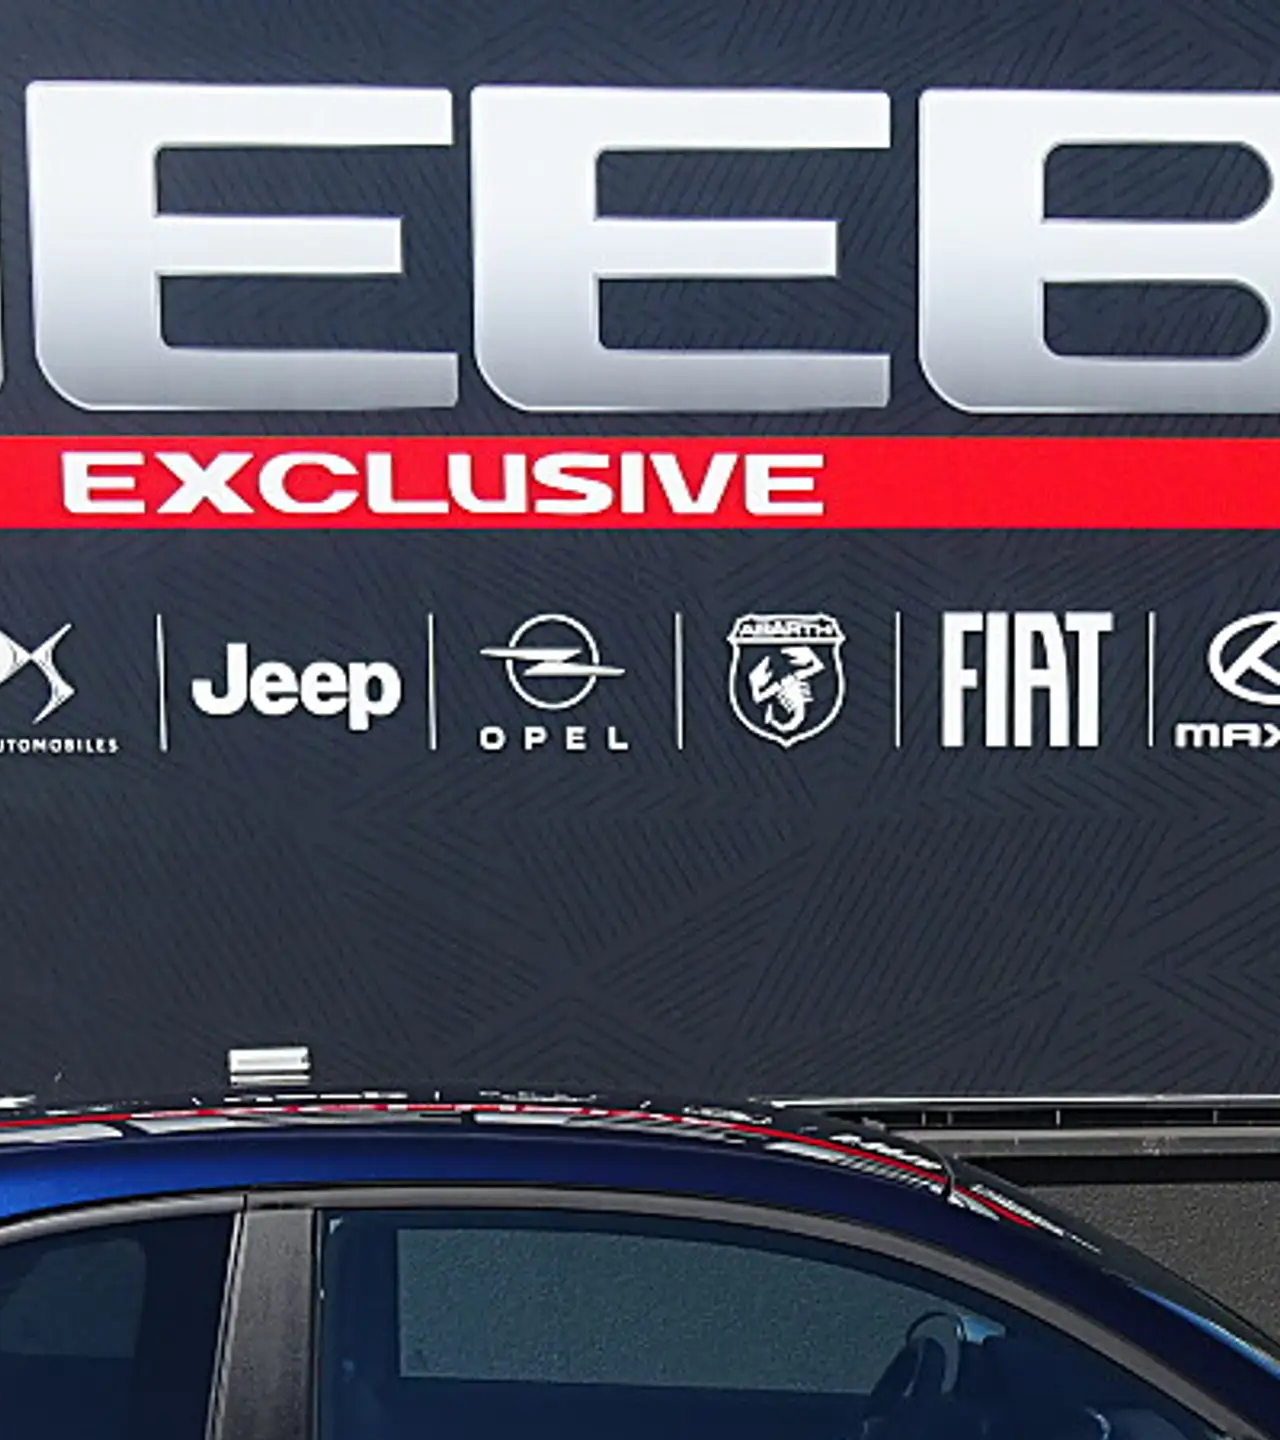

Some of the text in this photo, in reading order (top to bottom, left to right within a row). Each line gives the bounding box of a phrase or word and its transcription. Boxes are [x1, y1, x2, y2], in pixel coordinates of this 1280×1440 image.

[62, 452, 824, 516] EXCLUSIVE
[191, 642, 402, 731] Jeep
[942, 611, 1114, 748] FIAT
[480, 725, 629, 750] OPEL
